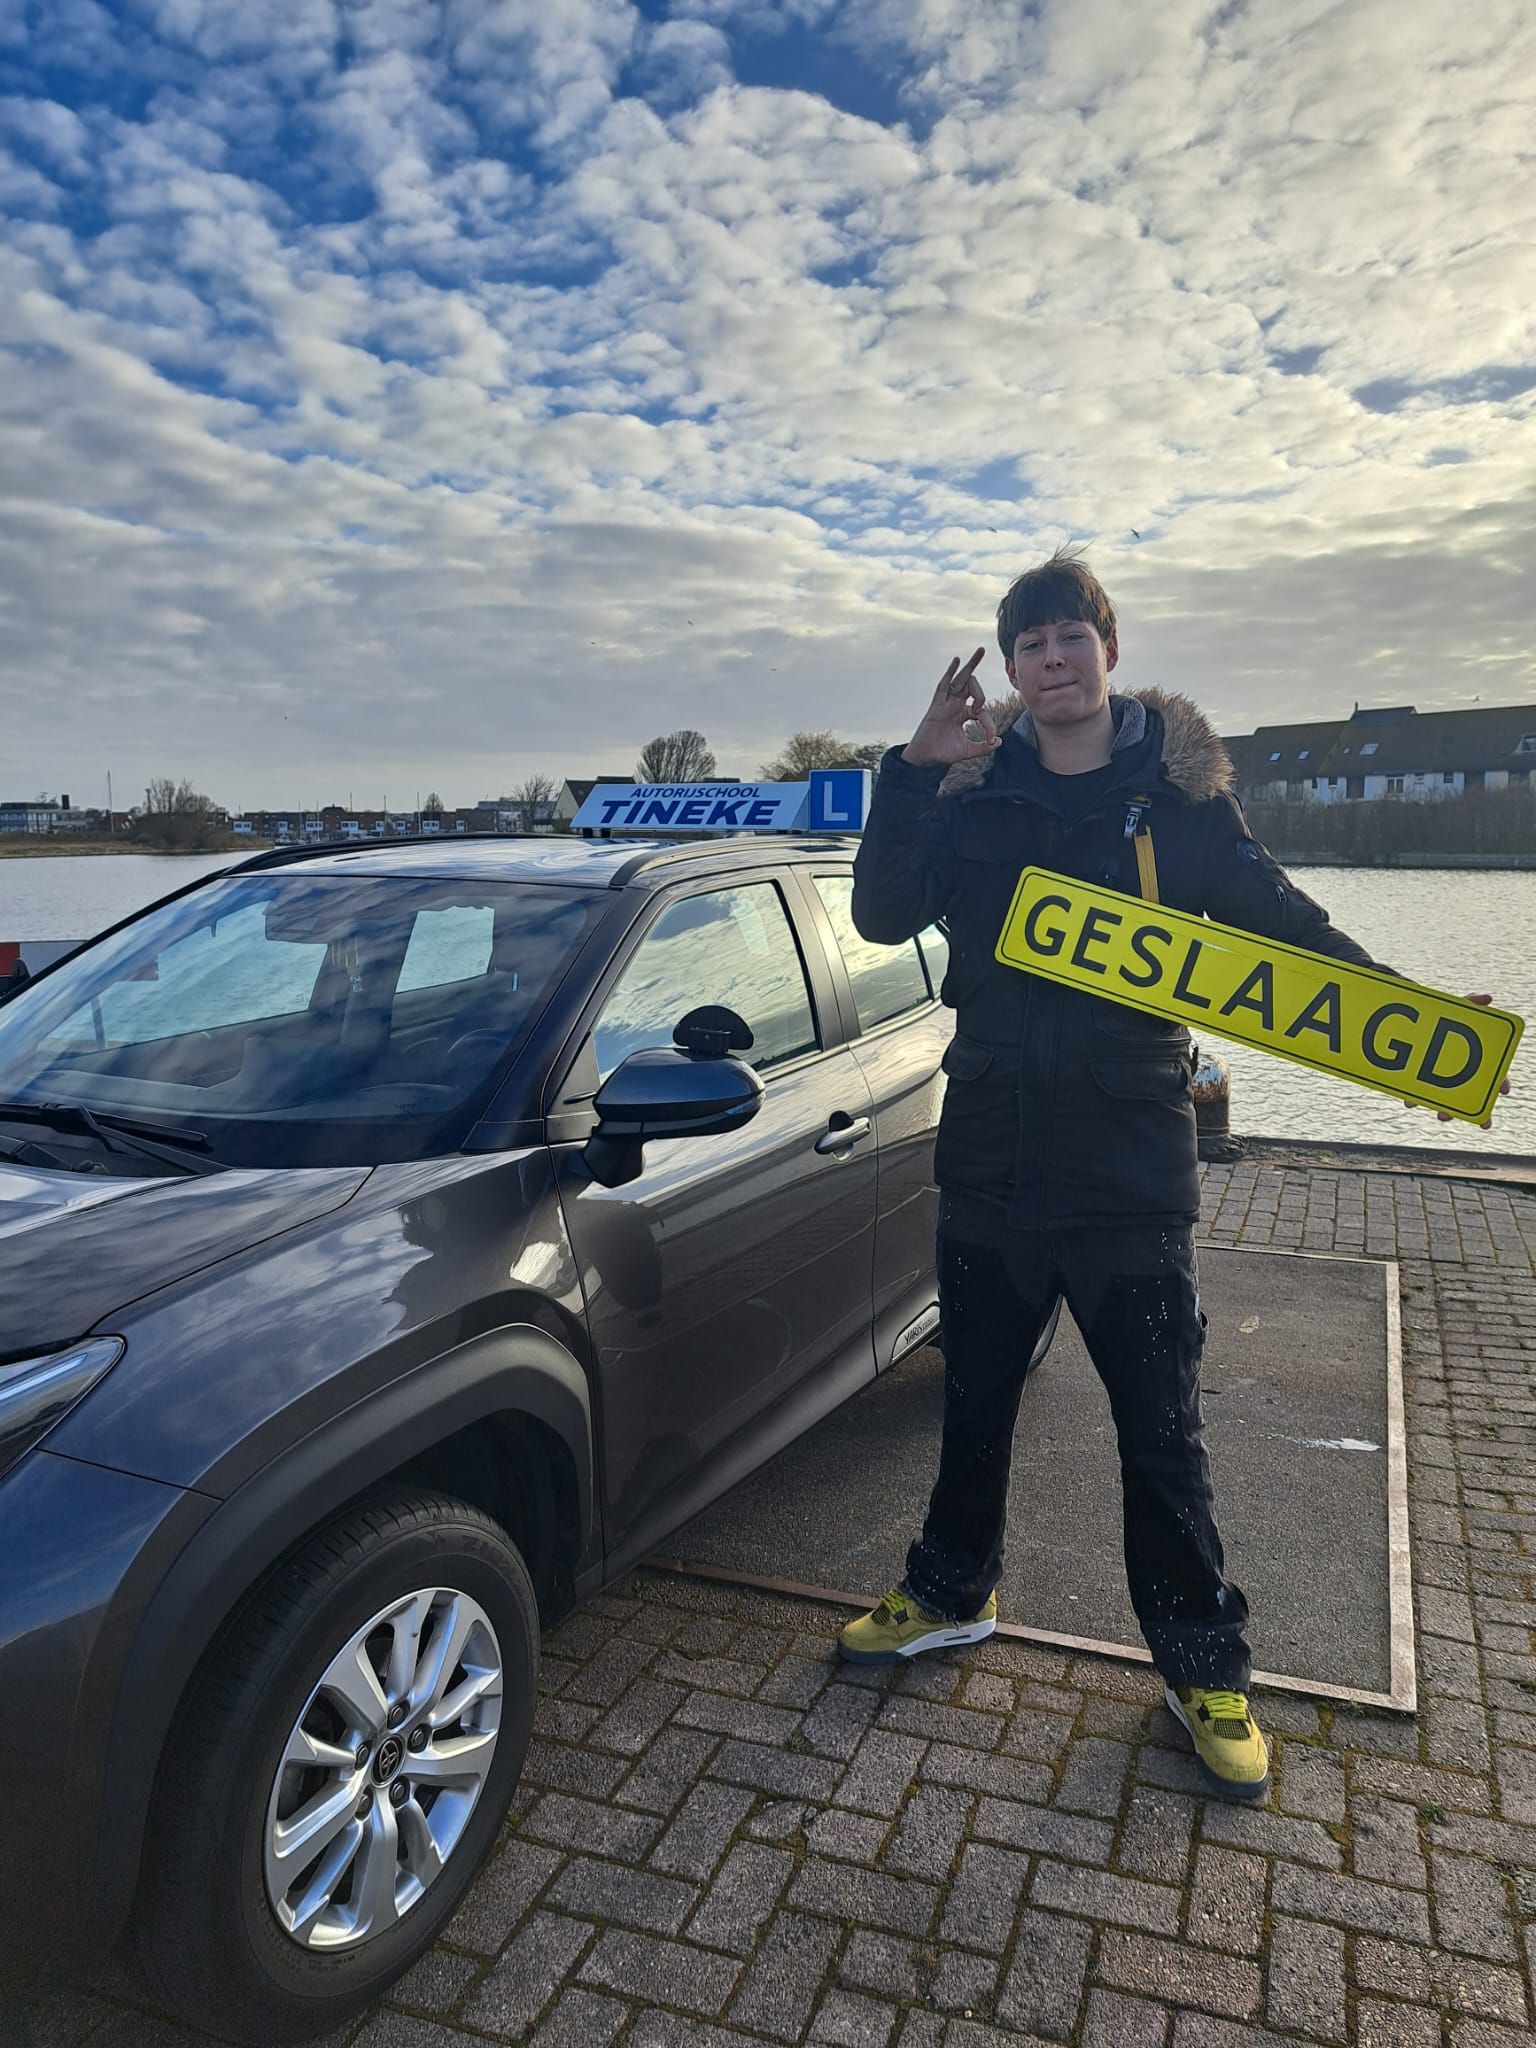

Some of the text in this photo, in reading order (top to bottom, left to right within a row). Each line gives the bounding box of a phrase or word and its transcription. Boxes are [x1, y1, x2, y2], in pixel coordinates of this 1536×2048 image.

[630, 787, 761, 799] AUTORIJSCHOOL
[823, 781, 849, 821] L
[600, 800, 781, 825] TINEKE
[1024, 895, 1483, 1089] GESLAAGD
